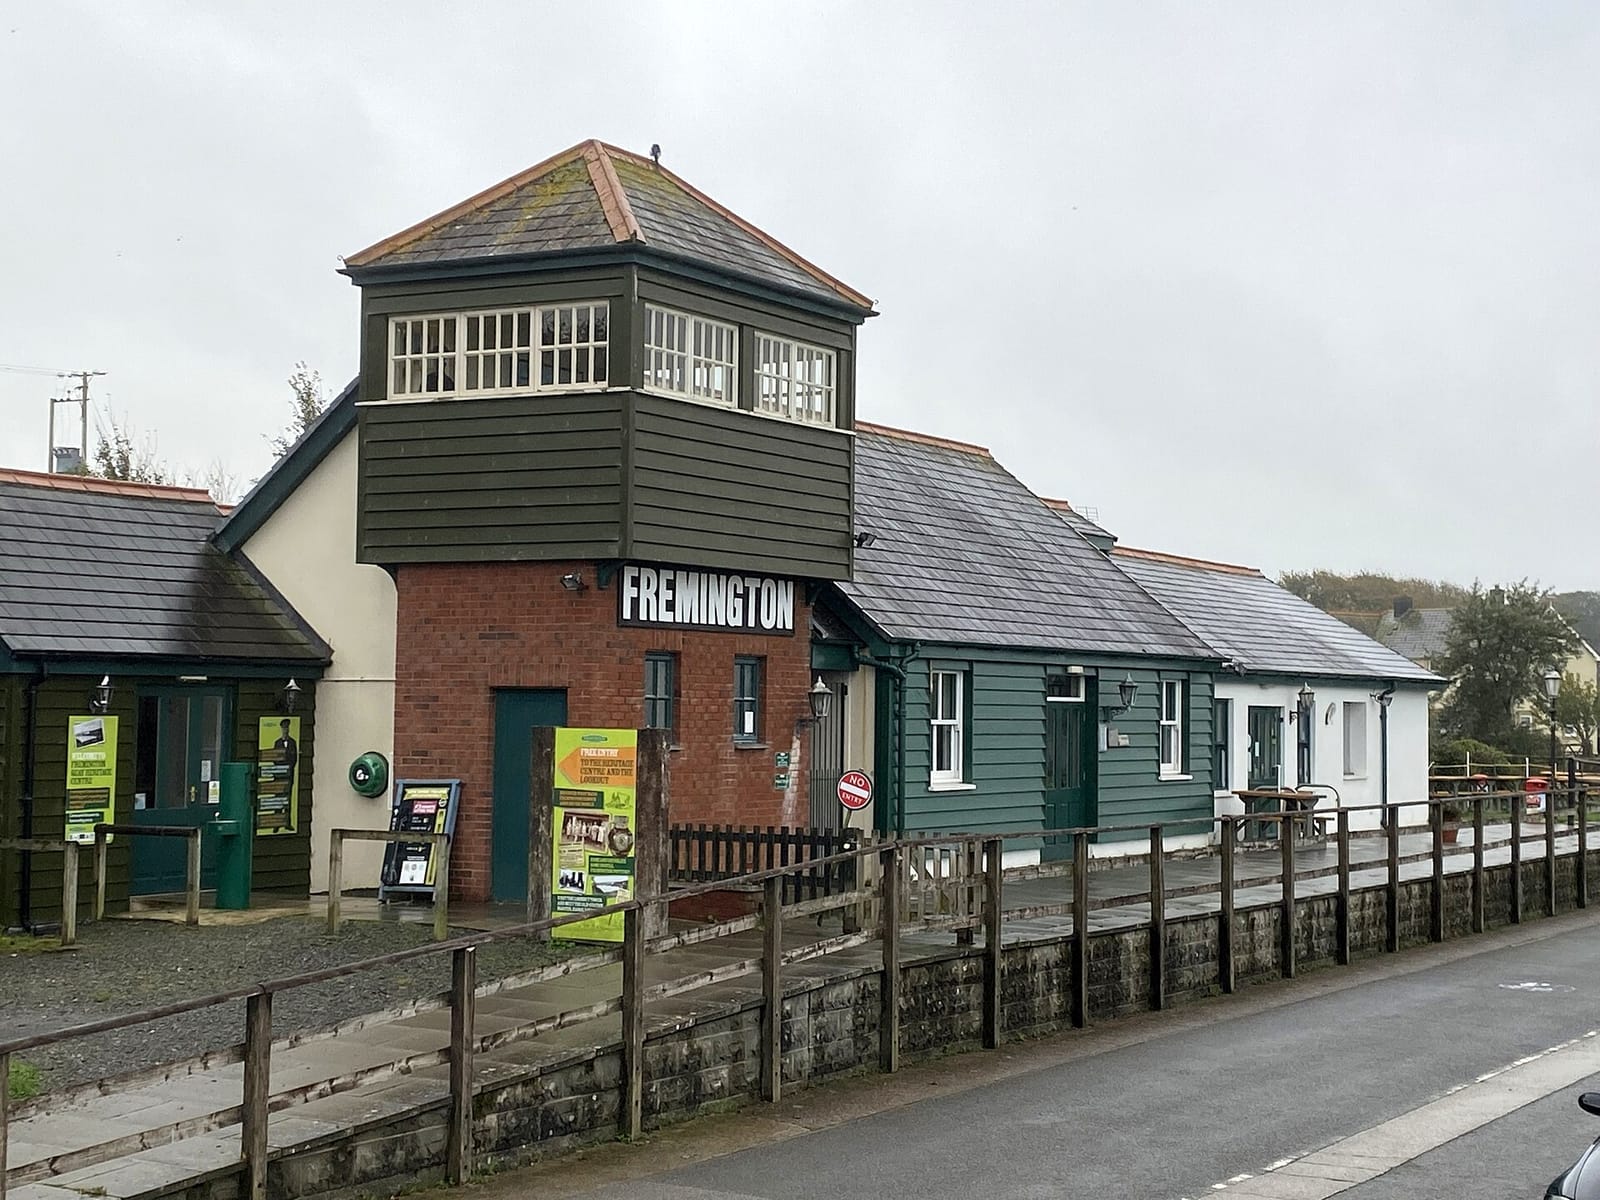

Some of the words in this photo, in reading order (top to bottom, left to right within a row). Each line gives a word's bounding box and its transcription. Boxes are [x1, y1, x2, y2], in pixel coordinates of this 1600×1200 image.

[622, 565, 794, 630] FREMINGTON
[580, 767, 606, 776] CENTRE
[606, 767, 621, 776] AND
[621, 768, 634, 777] THE
[849, 775, 865, 788] NO
[842, 791, 863, 805] ENTRY
